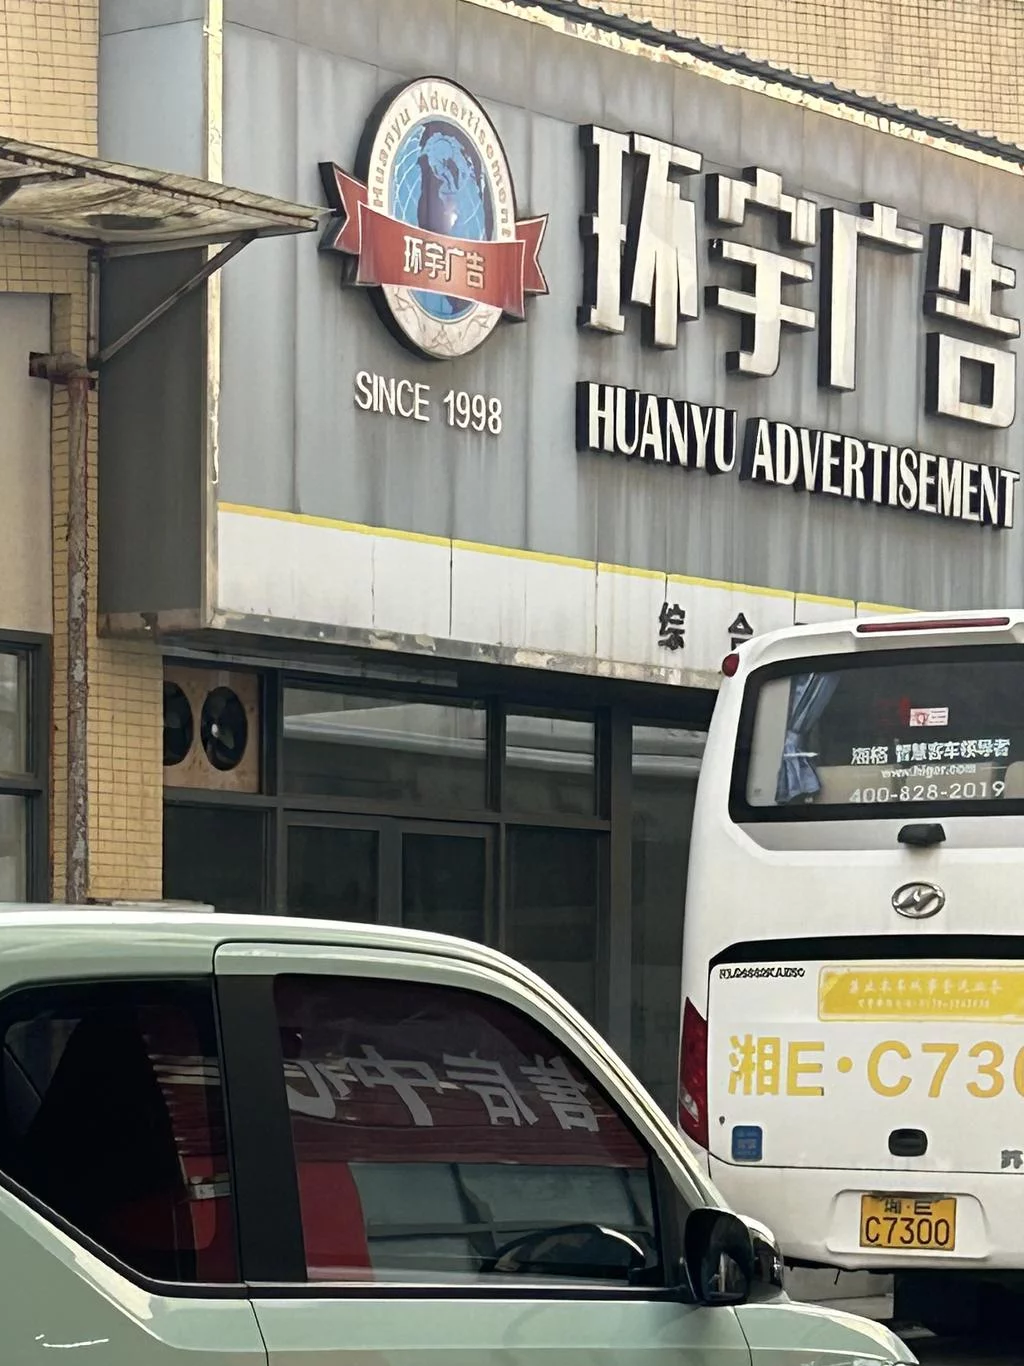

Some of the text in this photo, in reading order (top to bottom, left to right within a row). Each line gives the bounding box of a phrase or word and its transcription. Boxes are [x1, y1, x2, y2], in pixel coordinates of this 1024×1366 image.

[403, 234, 485, 289] 环宇广告
[579, 124, 1020, 427] 环宇广告
[354, 371, 502, 434] SINCE 1998
[577, 381, 1020, 529] HUANYU ADVERTISEMENT
[849, 781, 1005, 803] 400-828-2019
[728, 1033, 1024, 1098] 湘E·C73
[865, 1216, 949, 1246] C7300
